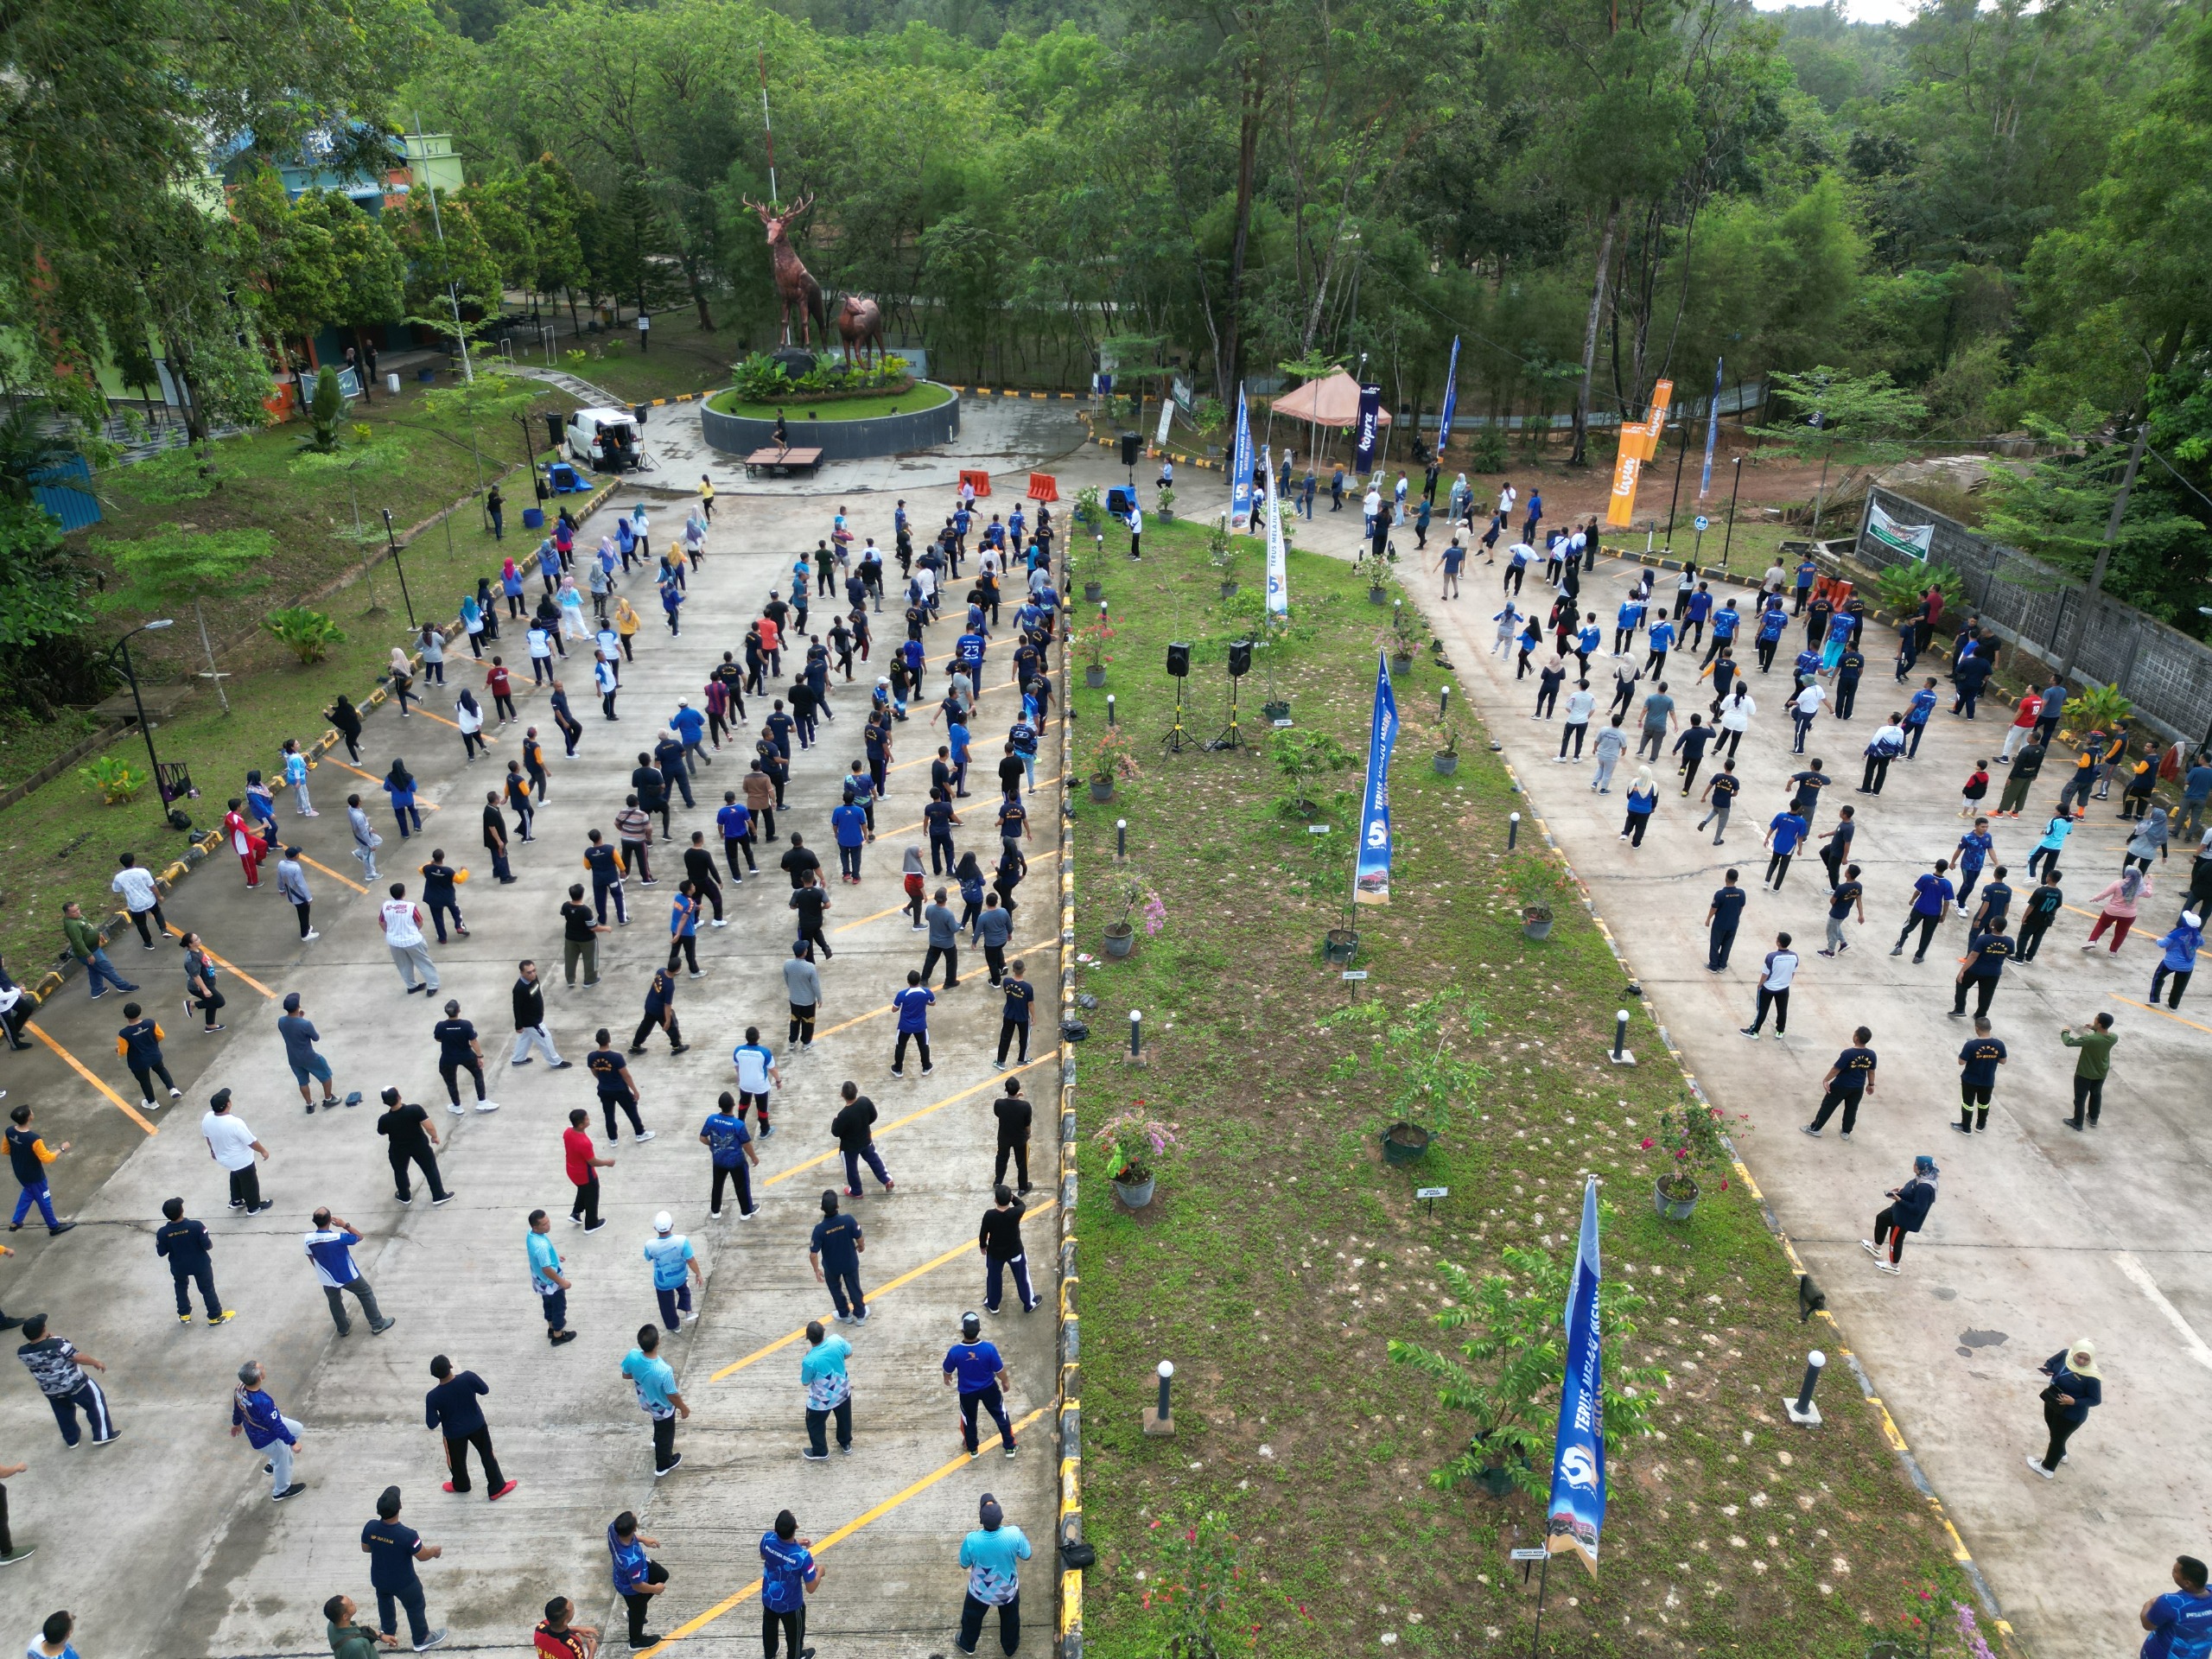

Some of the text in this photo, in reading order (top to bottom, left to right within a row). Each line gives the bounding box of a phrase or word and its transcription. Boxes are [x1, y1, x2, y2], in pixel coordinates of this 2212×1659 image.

[1358, 412, 1375, 451] kopra
[963, 645, 979, 657] 23
[1375, 781, 1383, 810] TERUS
[2040, 897, 2057, 912] 10
[1574, 1389, 1592, 1433] TERUS
